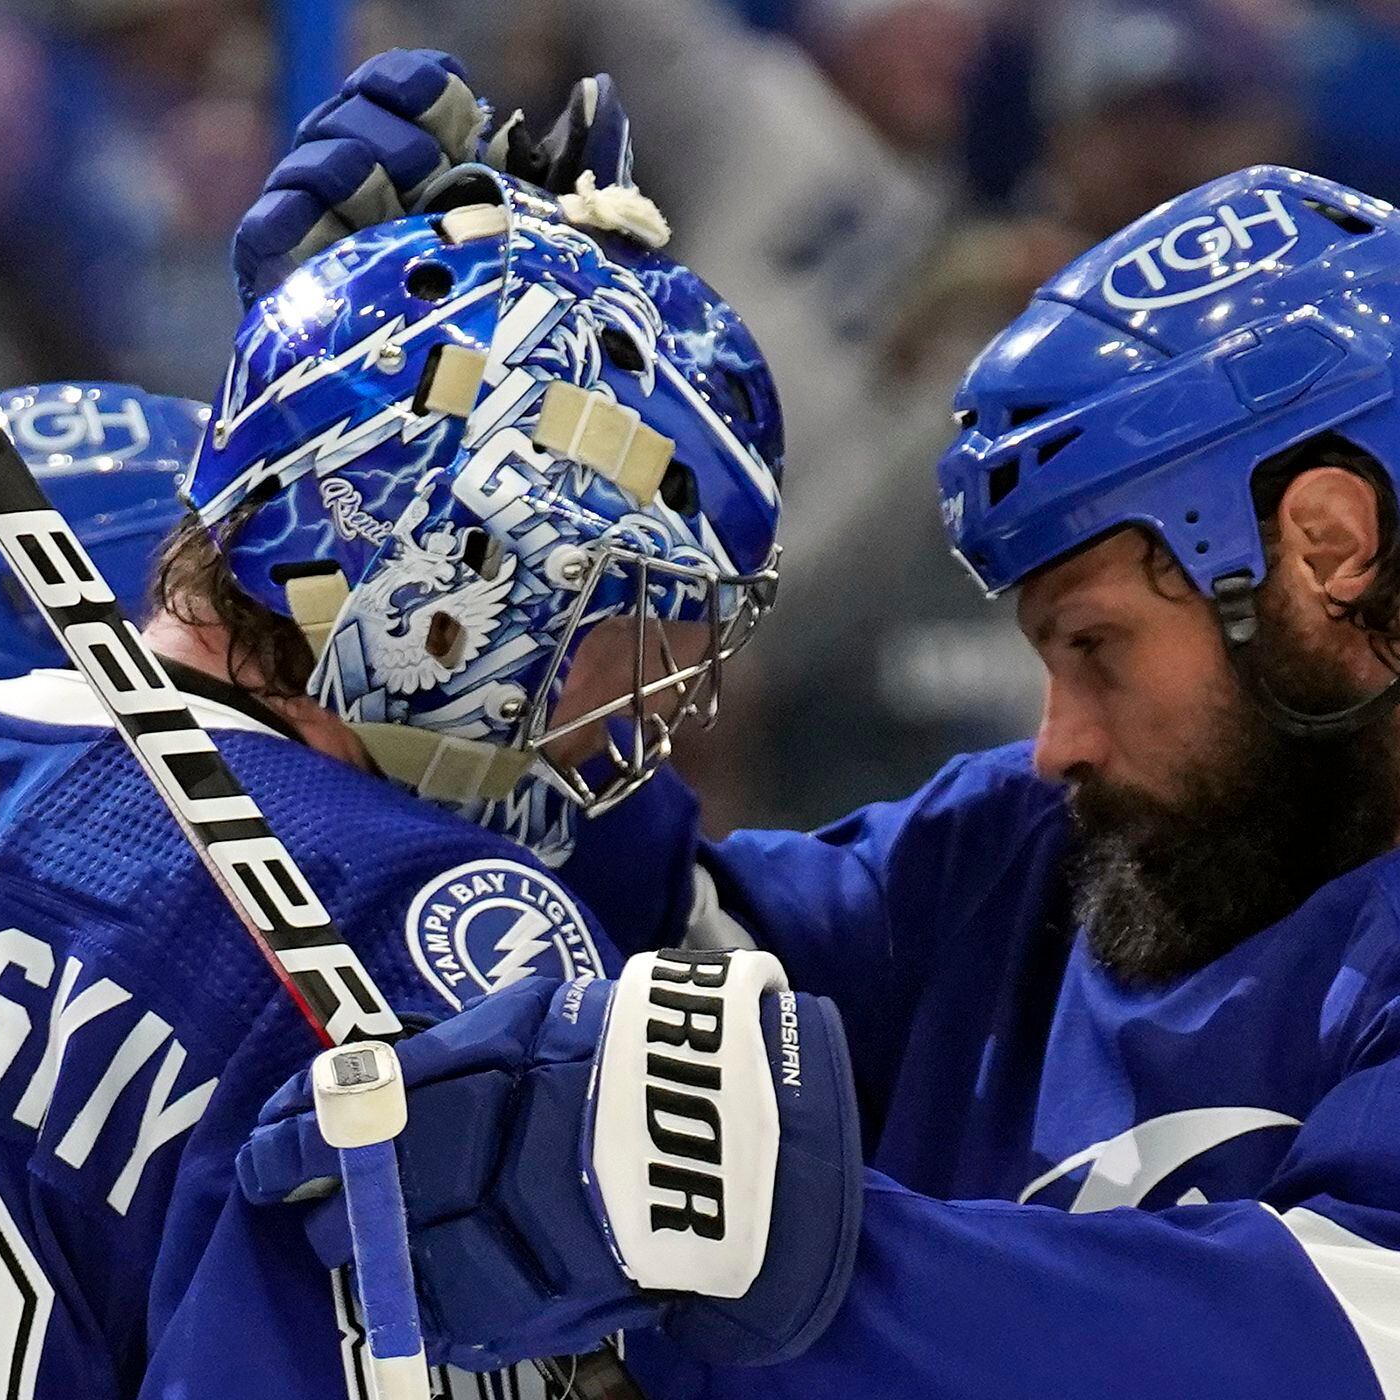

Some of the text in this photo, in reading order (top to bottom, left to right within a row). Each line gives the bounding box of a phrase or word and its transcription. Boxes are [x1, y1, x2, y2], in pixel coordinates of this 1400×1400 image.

[1114, 190, 1298, 292] TGH
[5, 398, 151, 452] GH
[423, 902, 467, 988] TAMPA
[448, 872, 506, 906] BAY
